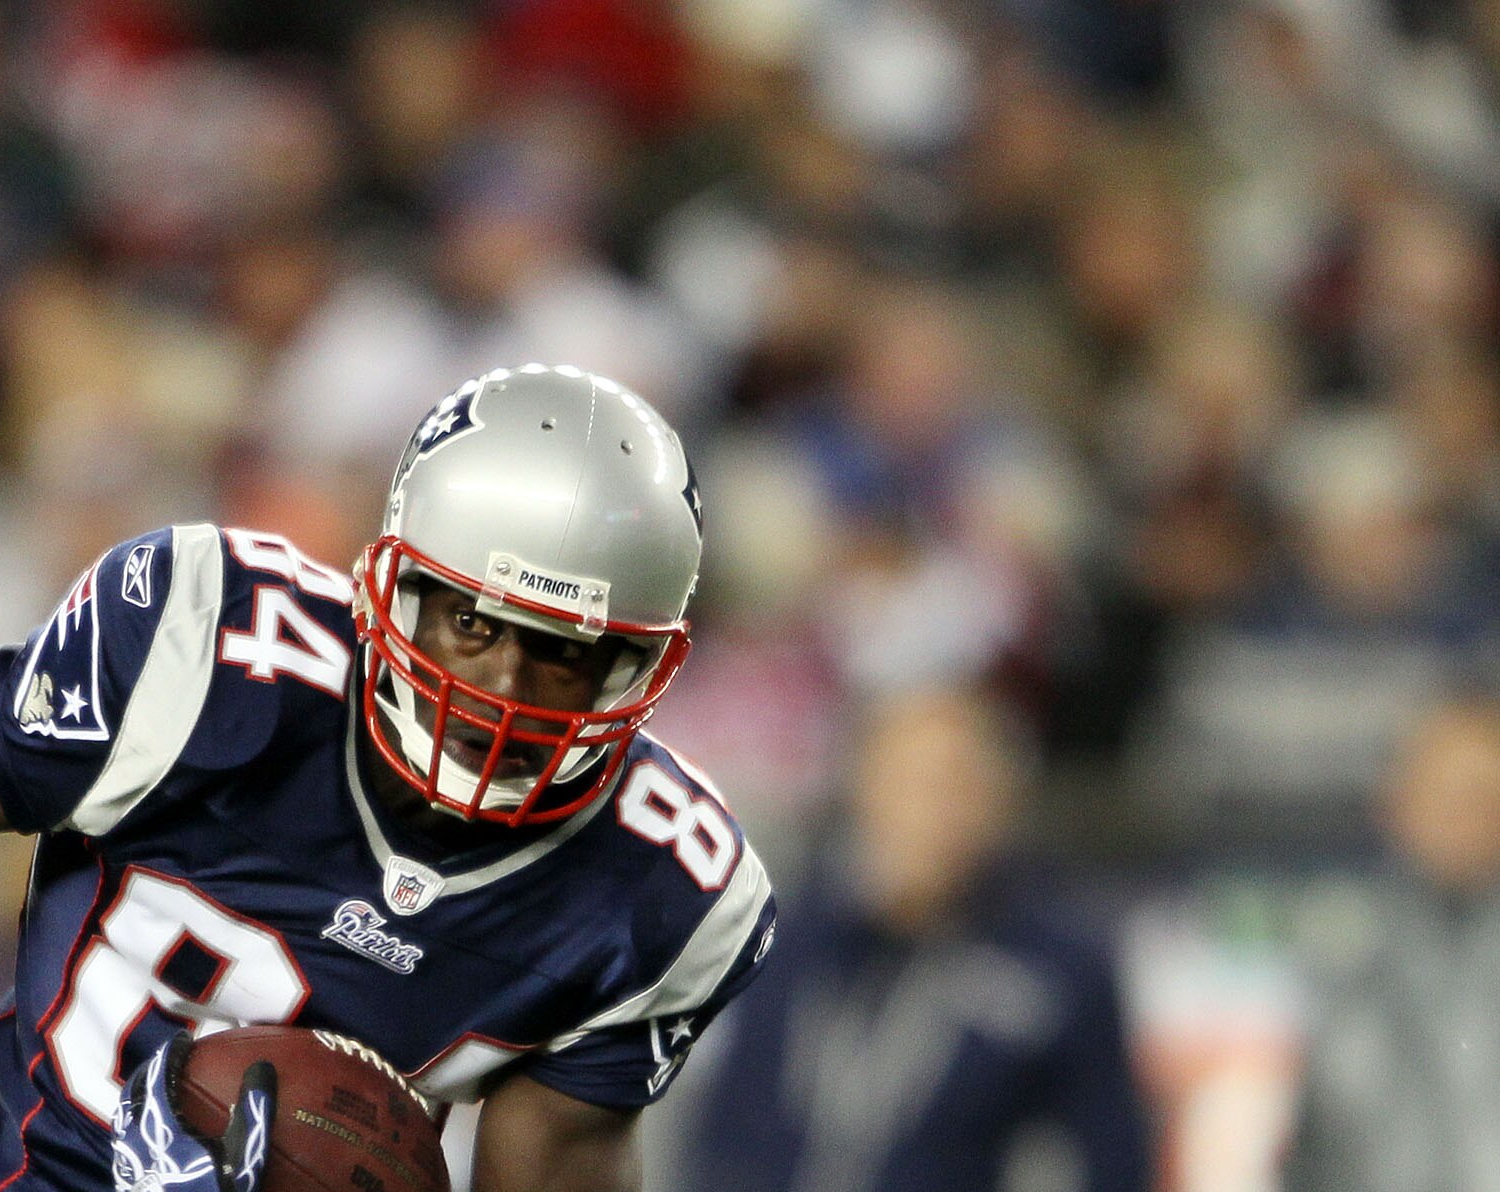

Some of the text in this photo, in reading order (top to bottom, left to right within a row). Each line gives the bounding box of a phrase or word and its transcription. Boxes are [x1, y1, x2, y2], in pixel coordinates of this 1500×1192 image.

[218, 528, 356, 700] 84
[518, 570, 580, 600] PATRIOTS
[615, 728, 740, 892] 8
[393, 884, 420, 908] NFL
[322, 911, 423, 973] Patriots
